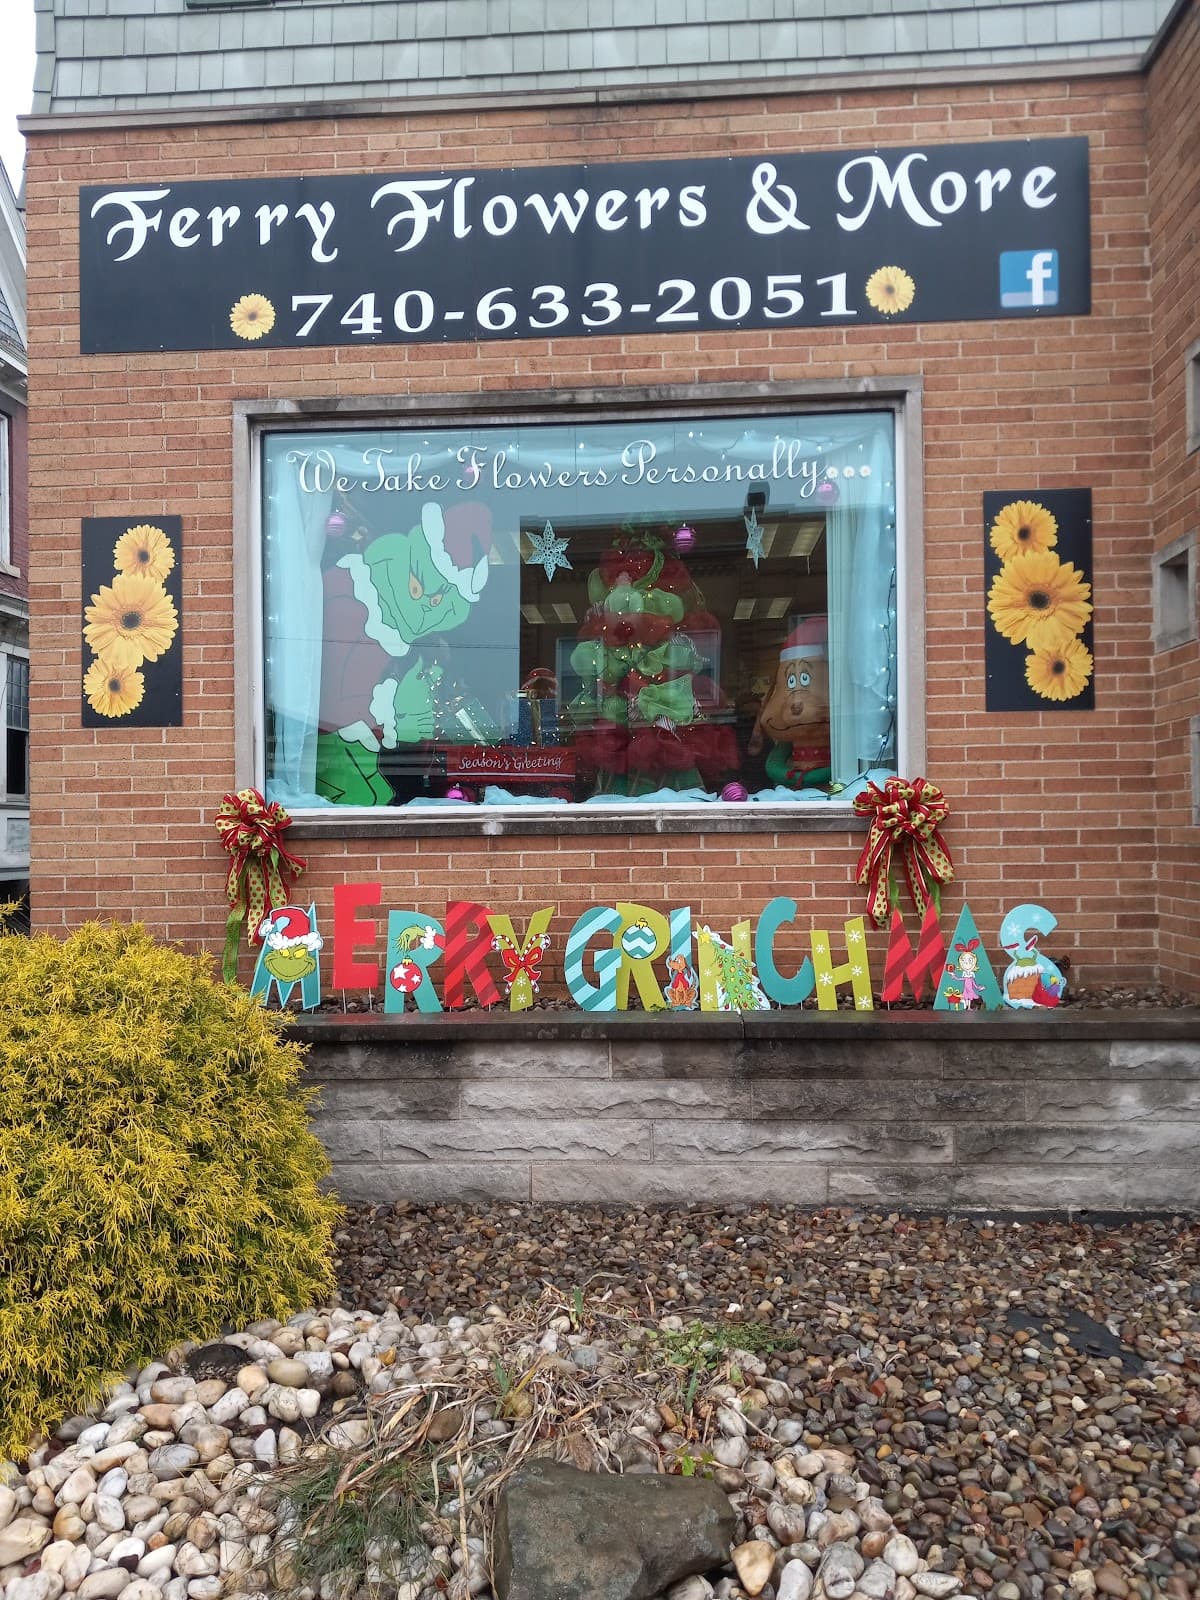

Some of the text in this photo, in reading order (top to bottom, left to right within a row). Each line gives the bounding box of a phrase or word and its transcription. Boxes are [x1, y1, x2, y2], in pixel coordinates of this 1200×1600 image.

[90, 152, 1058, 264] Ferry Flowers & More
[290, 272, 858, 338] 740-633-2051
[1025, 251, 1053, 306] f
[286, 449, 358, 494] We
[361, 446, 453, 492] Take
[456, 445, 619, 490] Flowers
[458, 754, 564, 771] Season's Greeting
[250, 882, 1067, 1014] MERRY GRINCHMAS
